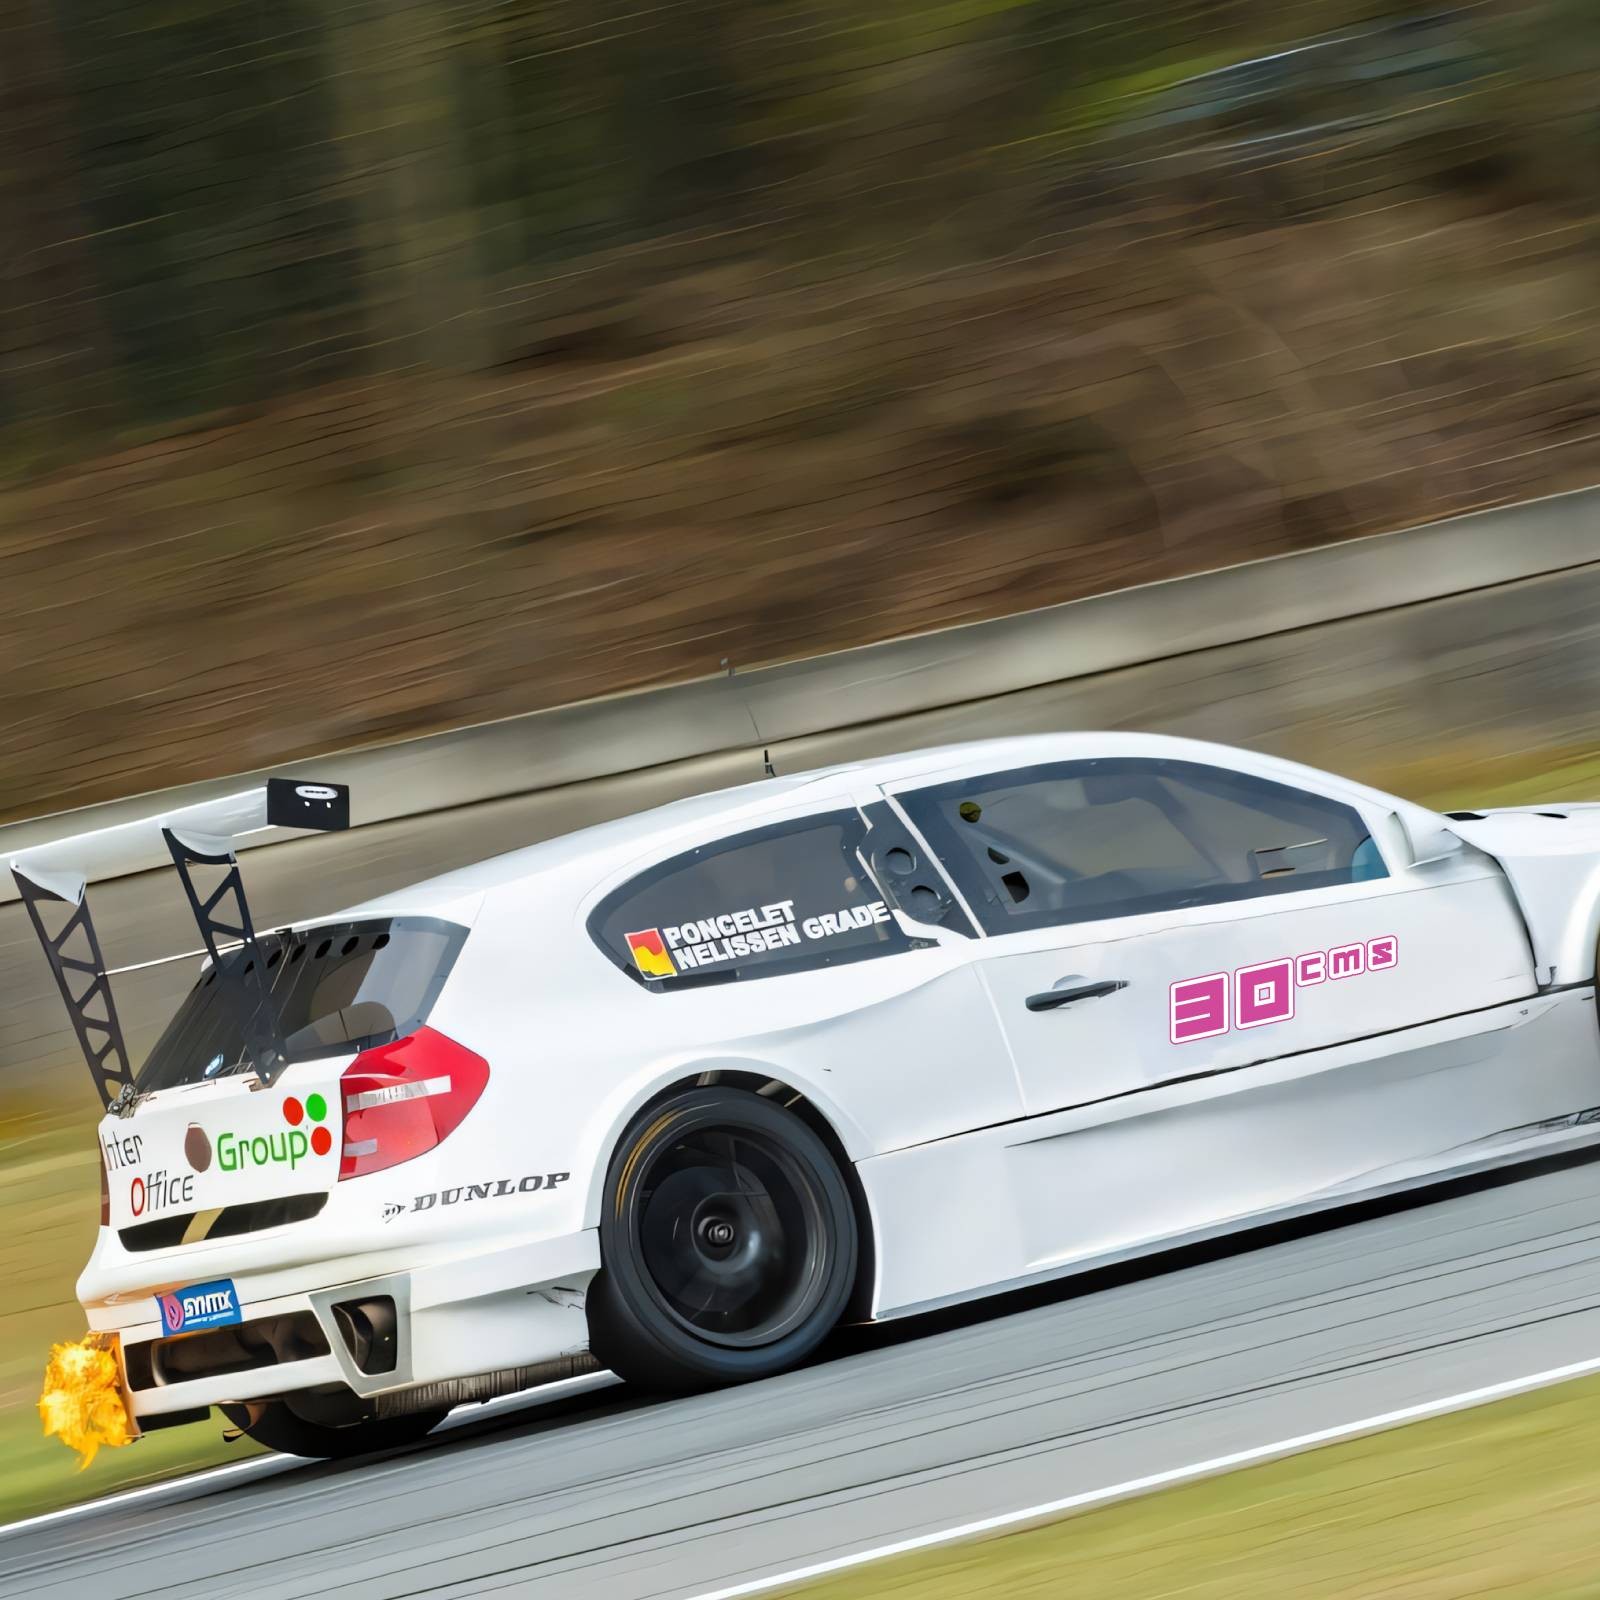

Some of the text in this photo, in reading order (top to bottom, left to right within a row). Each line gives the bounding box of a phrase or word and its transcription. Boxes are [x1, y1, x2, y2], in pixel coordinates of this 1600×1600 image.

[662, 900, 796, 949] PONCELET
[672, 901, 891, 970] NELISSEN GRADE
[217, 1130, 308, 1171] Group
[131, 1170, 194, 1217] Office
[410, 1172, 570, 1212] DUNLOP
